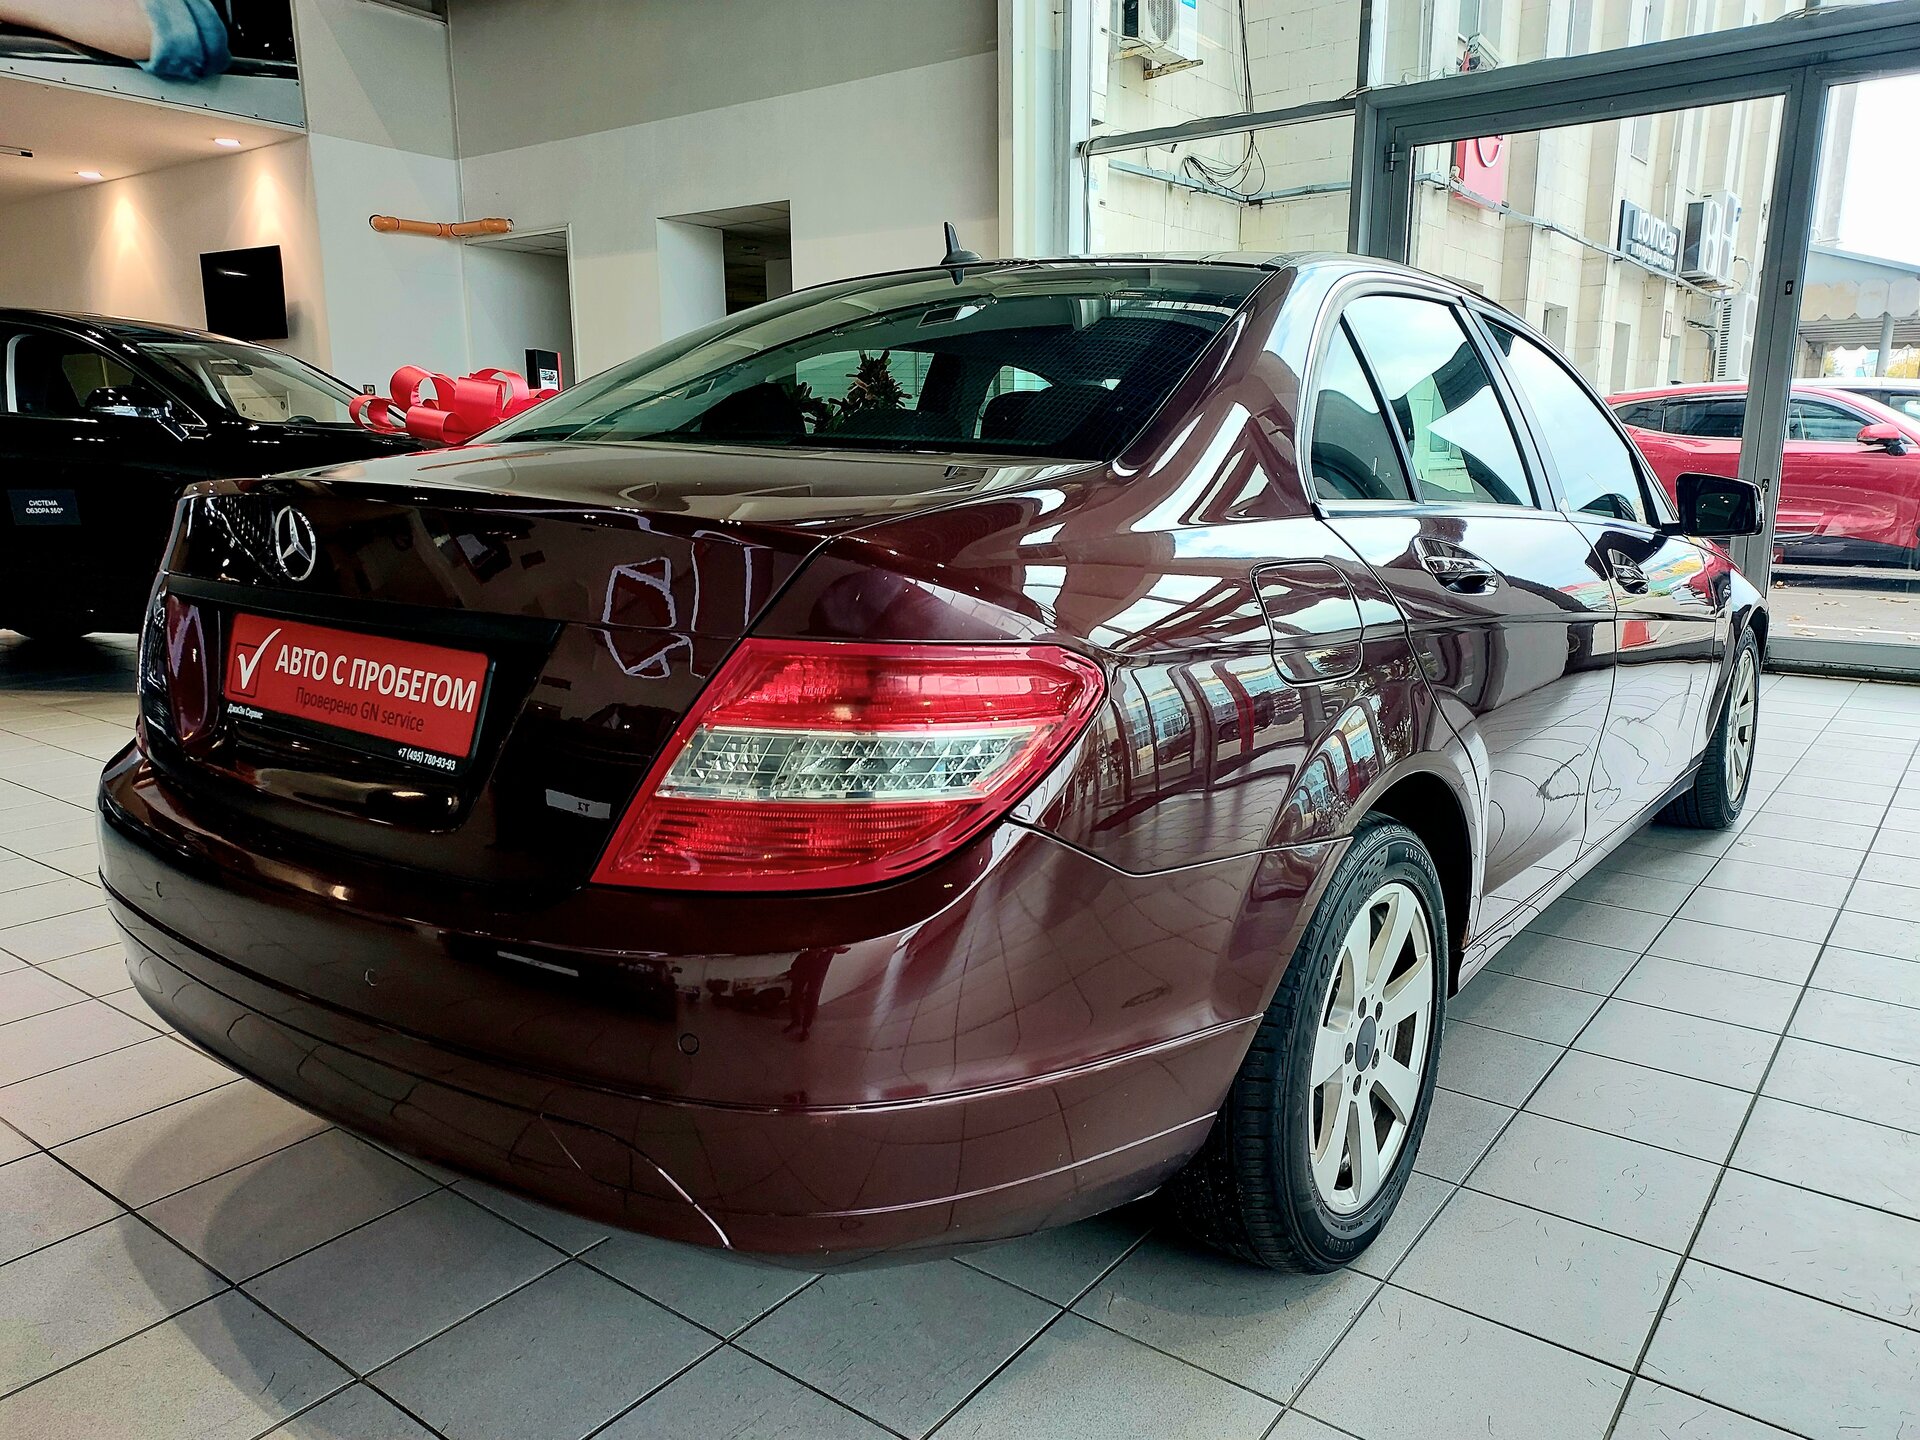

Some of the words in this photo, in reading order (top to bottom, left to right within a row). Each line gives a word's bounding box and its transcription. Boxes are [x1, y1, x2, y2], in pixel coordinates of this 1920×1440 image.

[275, 644, 328, 681] АВТО
[332, 655, 347, 685] С
[349, 659, 478, 713] ПРОБЕГОМ
[296, 687, 355, 717] Проверено
[360, 701, 380, 723] GN
[381, 708, 424, 732] service
[398, 747, 408, 758] +7
[406, 748, 424, 764] (495)
[423, 754, 457, 771] 780-93-93
